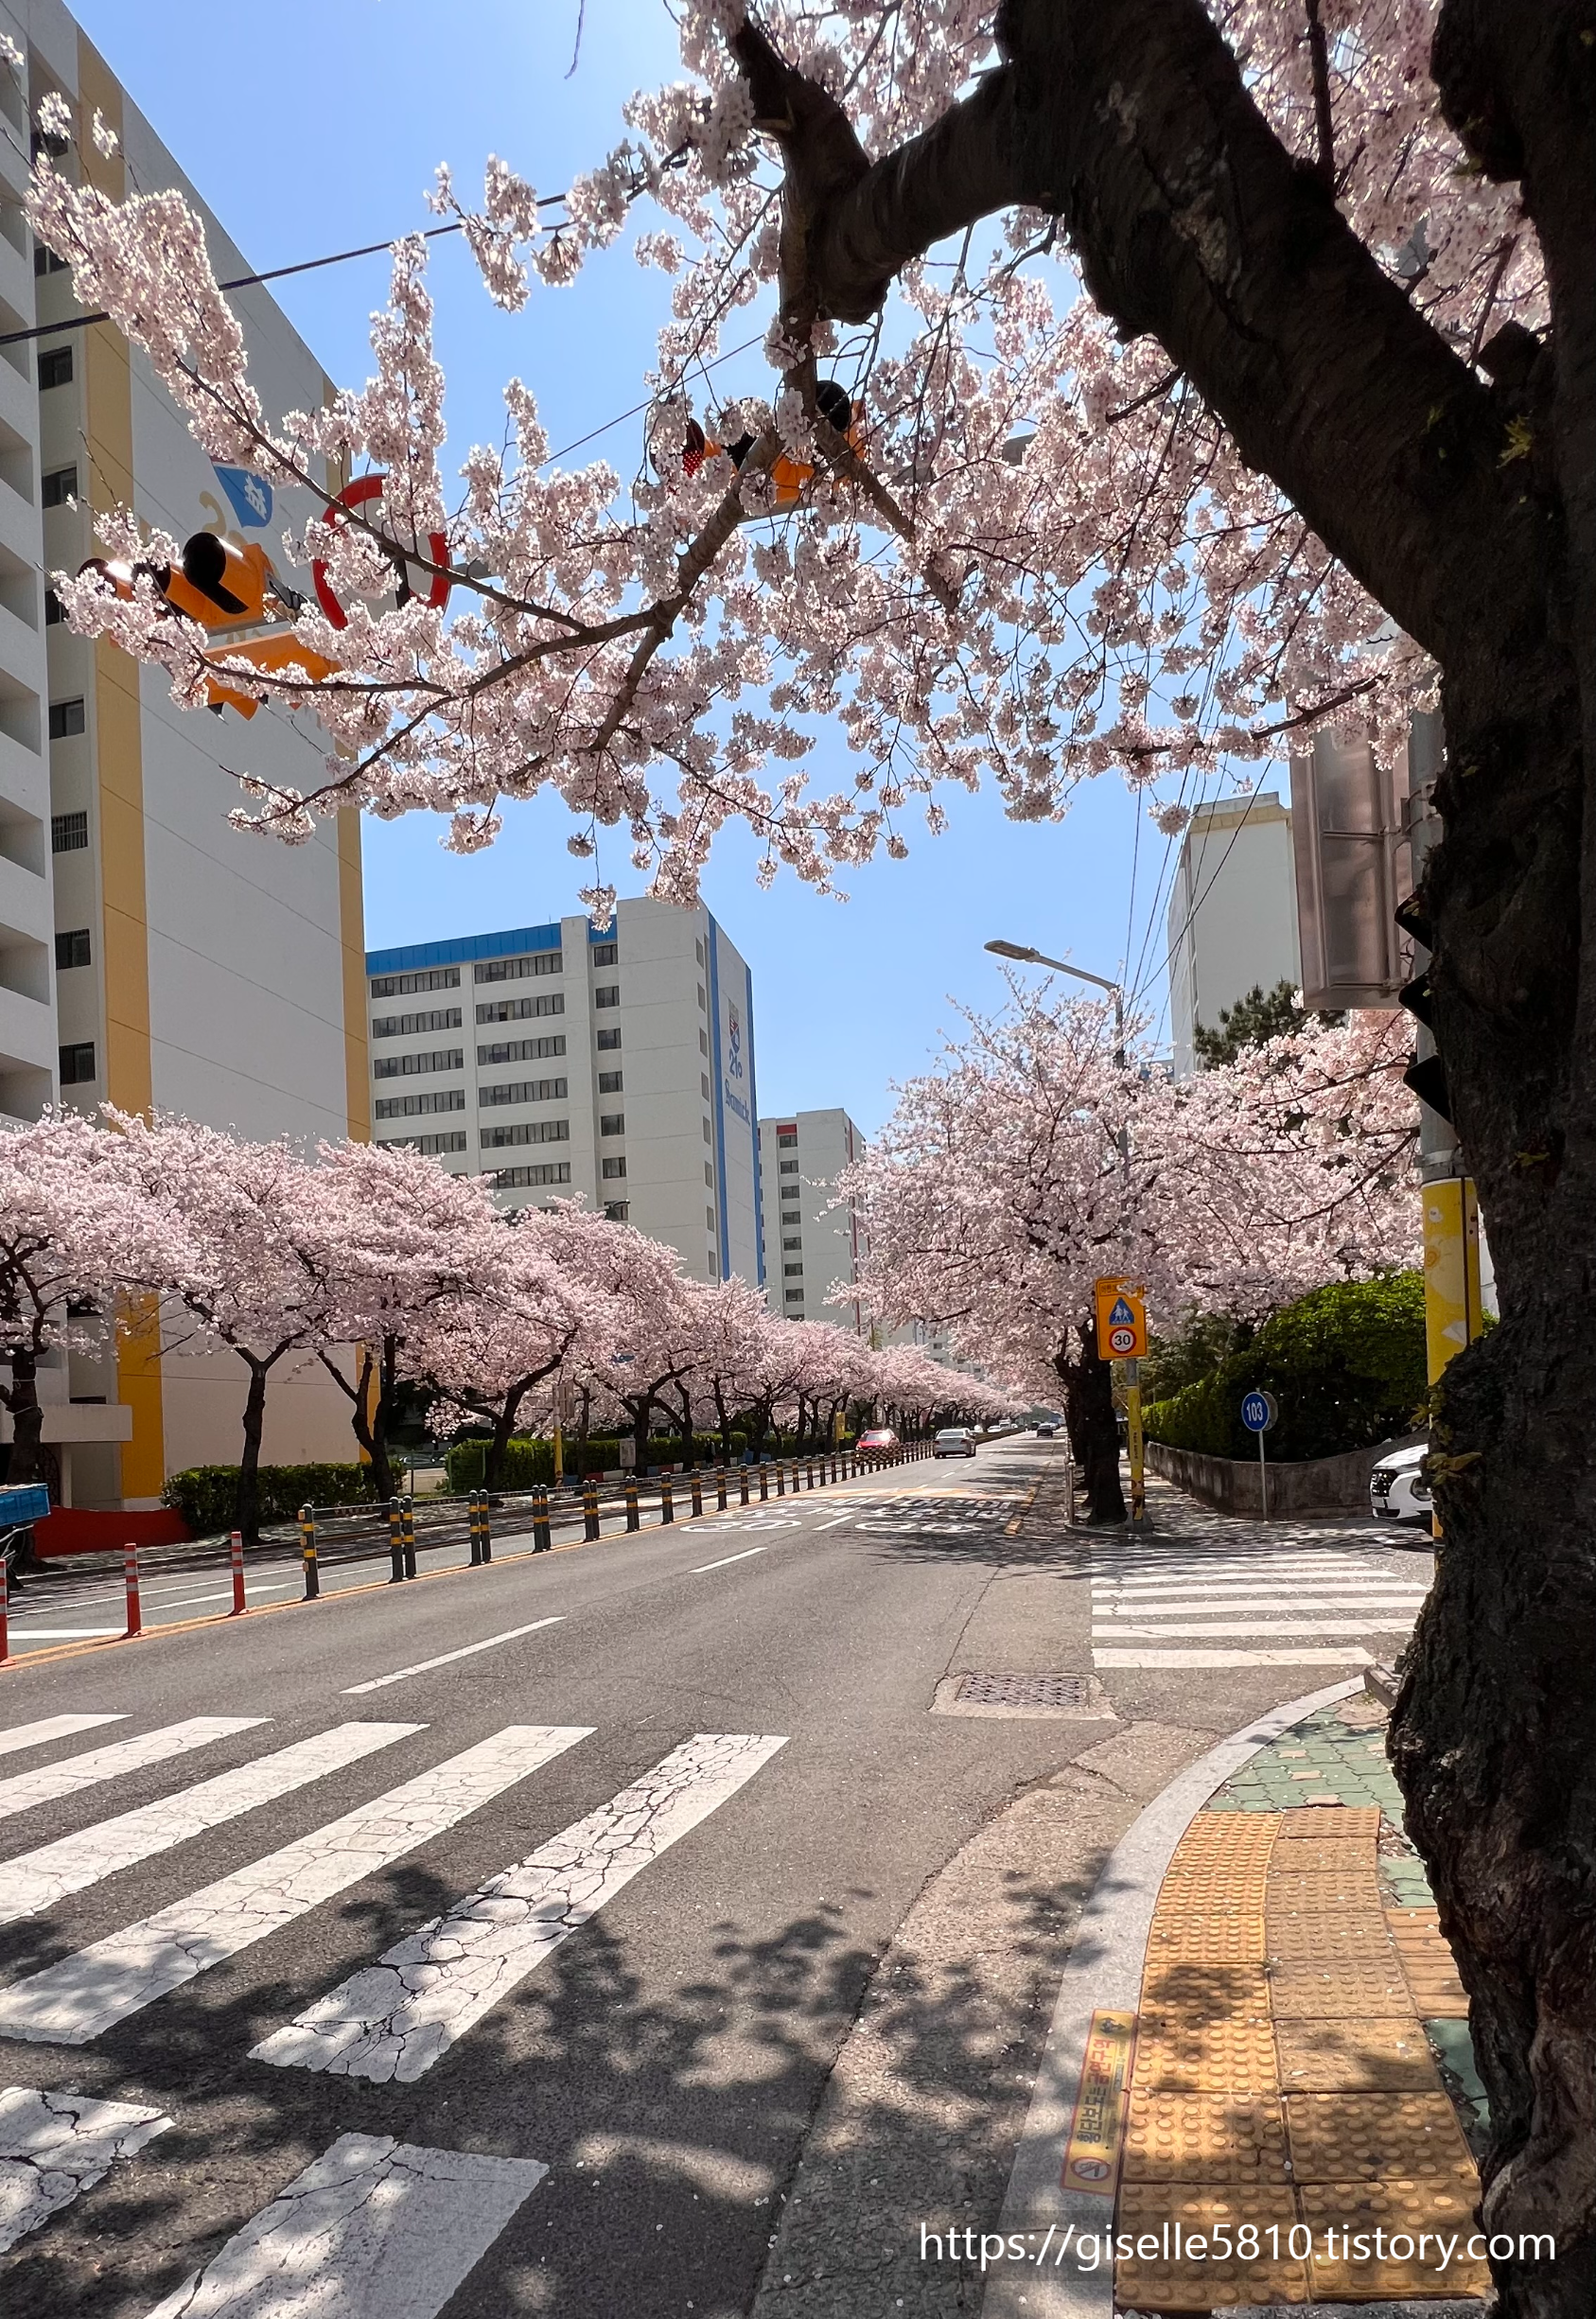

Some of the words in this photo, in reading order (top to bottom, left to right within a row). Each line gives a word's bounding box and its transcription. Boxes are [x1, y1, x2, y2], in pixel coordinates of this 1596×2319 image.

[1114, 1334, 1131, 1345] 30
[1246, 1402, 1263, 1421] 103
[1089, 2040, 1114, 2084] 금연구역
